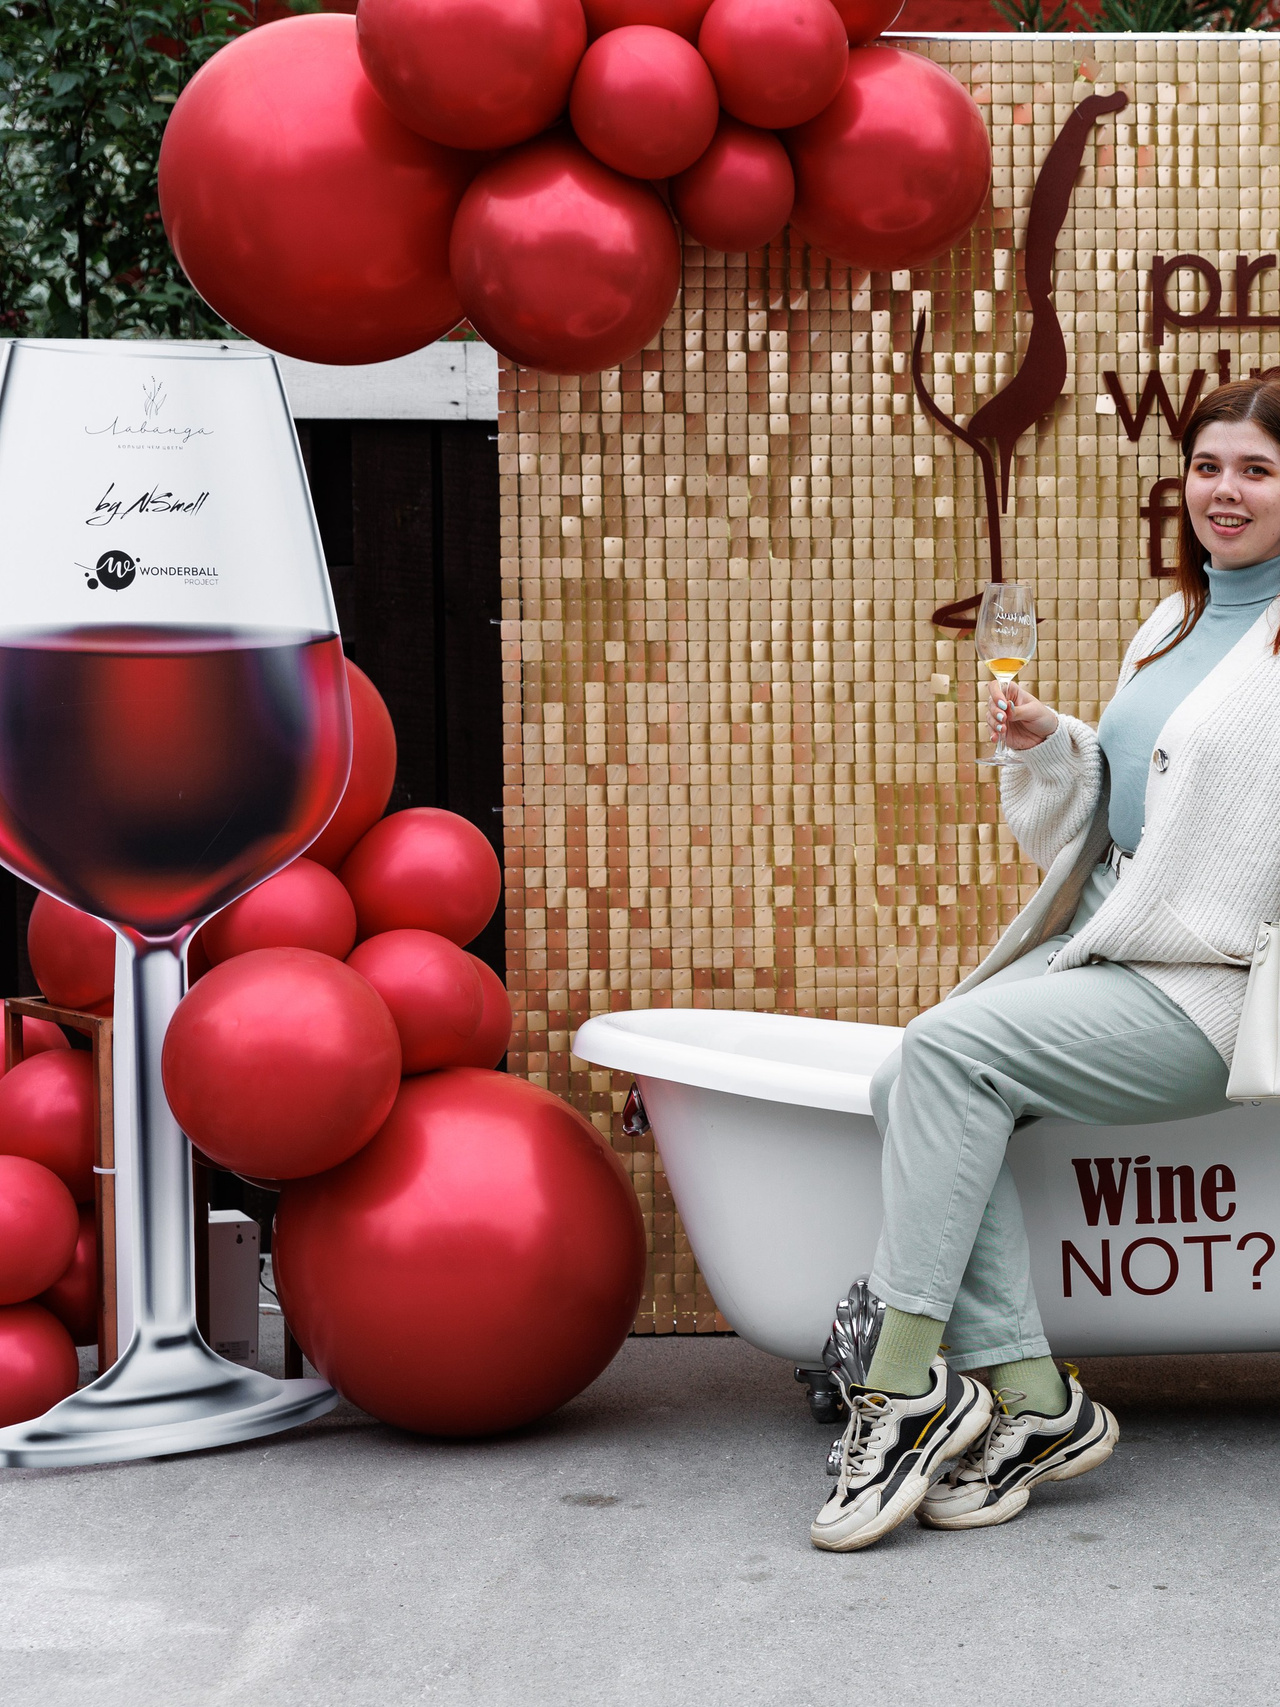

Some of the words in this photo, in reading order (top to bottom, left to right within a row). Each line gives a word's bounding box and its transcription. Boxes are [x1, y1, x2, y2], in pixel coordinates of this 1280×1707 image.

[85, 482, 123, 526] by
[120, 484, 210, 519] N.Smell
[139, 567, 219, 577] WONDERBALL
[184, 578, 219, 586] PROJECT
[1071, 1155, 1236, 1226] Wine
[1061, 1232, 1276, 1297] NOT?
